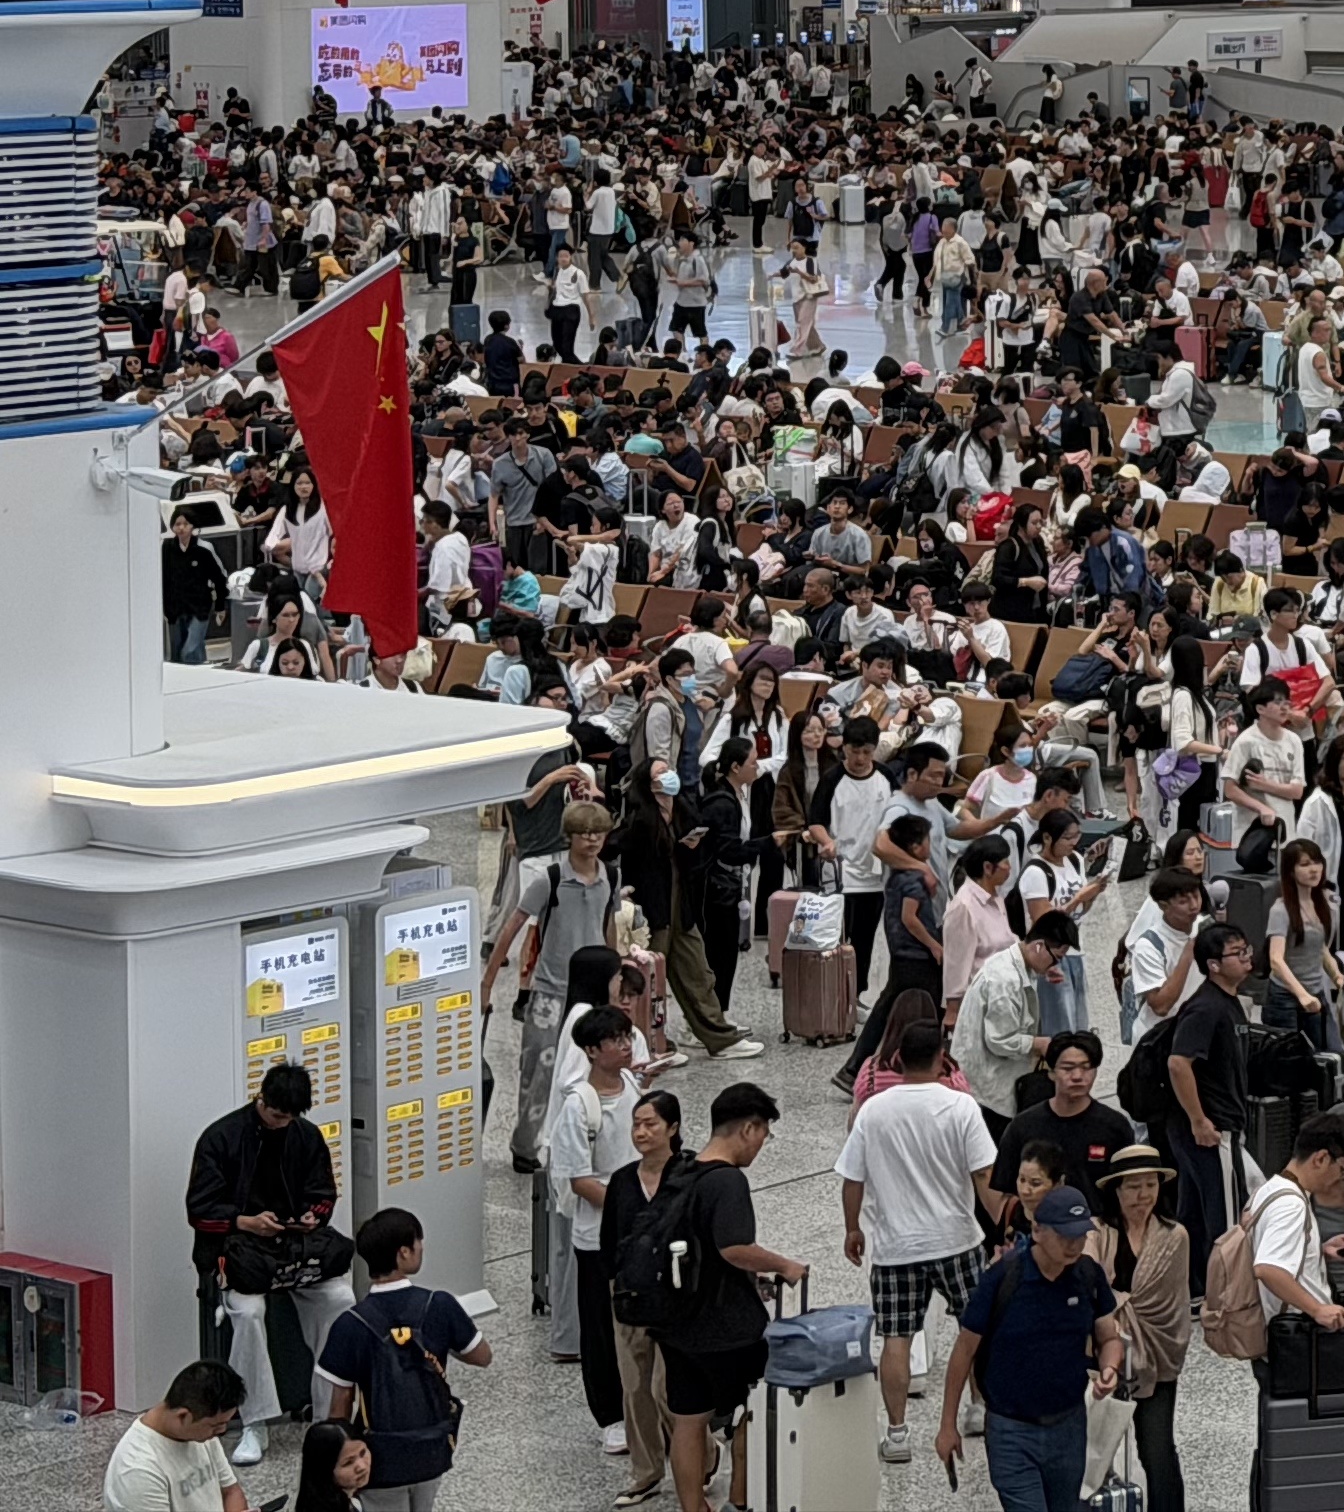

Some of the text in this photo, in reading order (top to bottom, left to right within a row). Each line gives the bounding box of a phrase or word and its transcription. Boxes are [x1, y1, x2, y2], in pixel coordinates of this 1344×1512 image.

[397, 918, 459, 944] 手机充电站
[260, 948, 326, 974] 手机充电站
